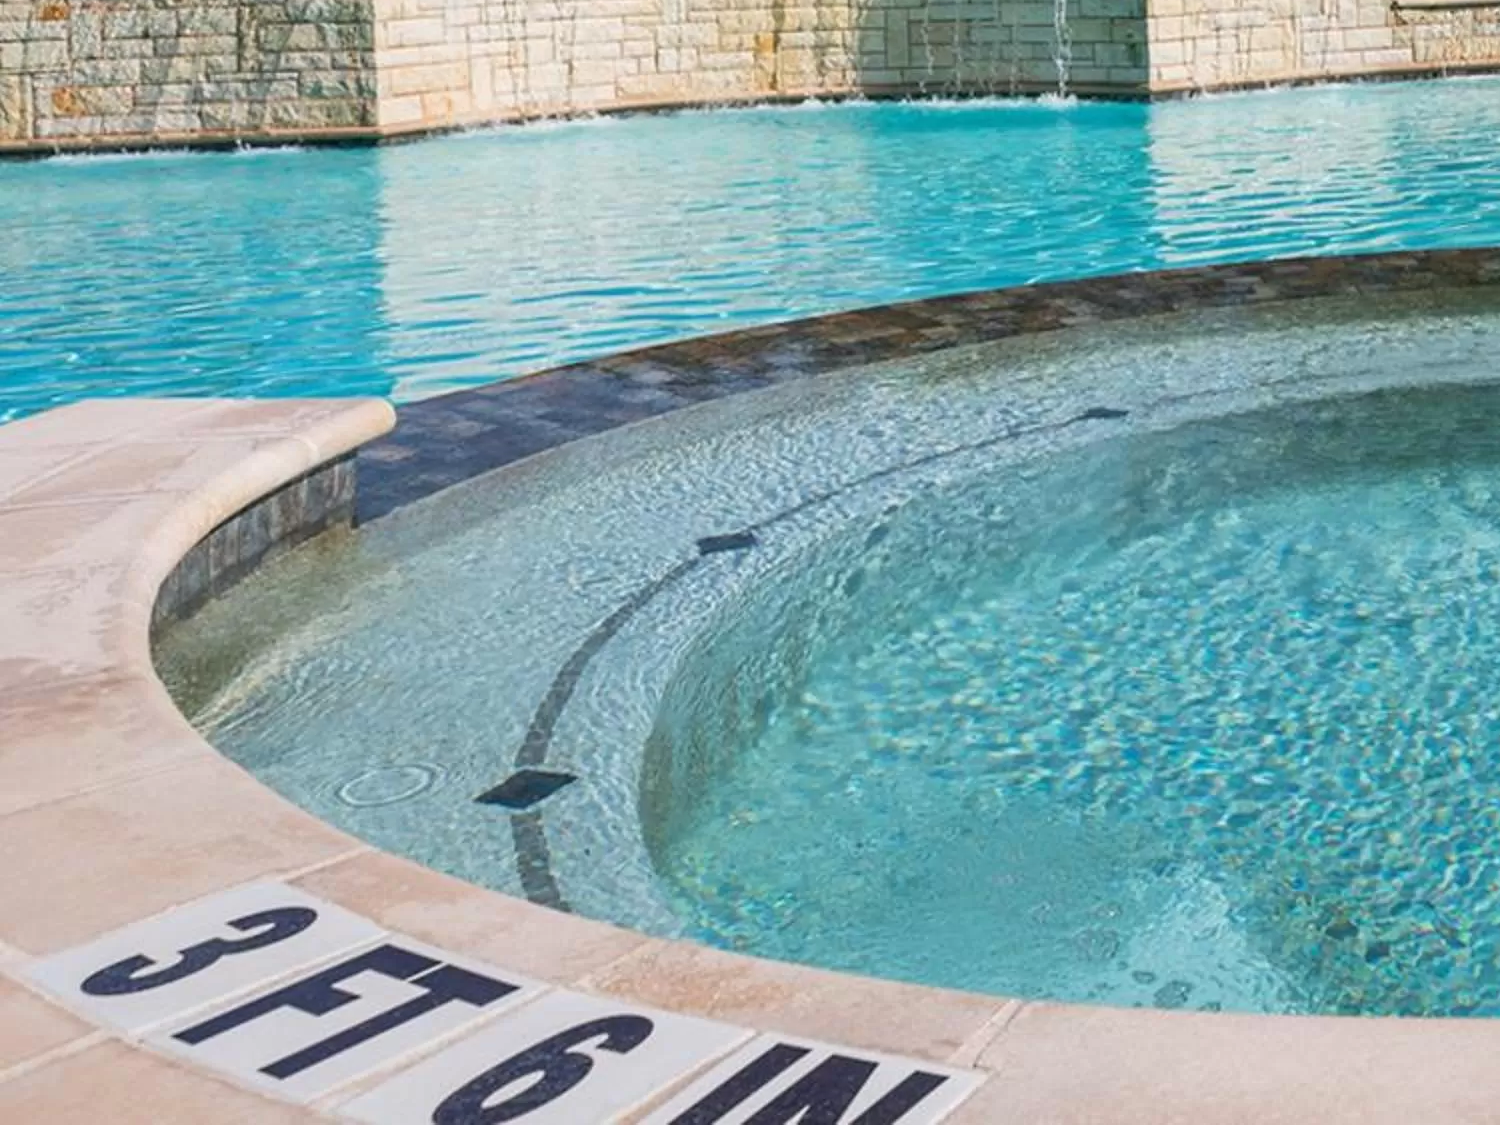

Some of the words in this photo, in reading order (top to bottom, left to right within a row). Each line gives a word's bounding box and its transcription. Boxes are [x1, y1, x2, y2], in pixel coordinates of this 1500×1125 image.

[80, 906, 318, 996] 3
[171, 943, 521, 1079] FT
[432, 1014, 655, 1125] 6
[667, 1042, 951, 1125] IN
